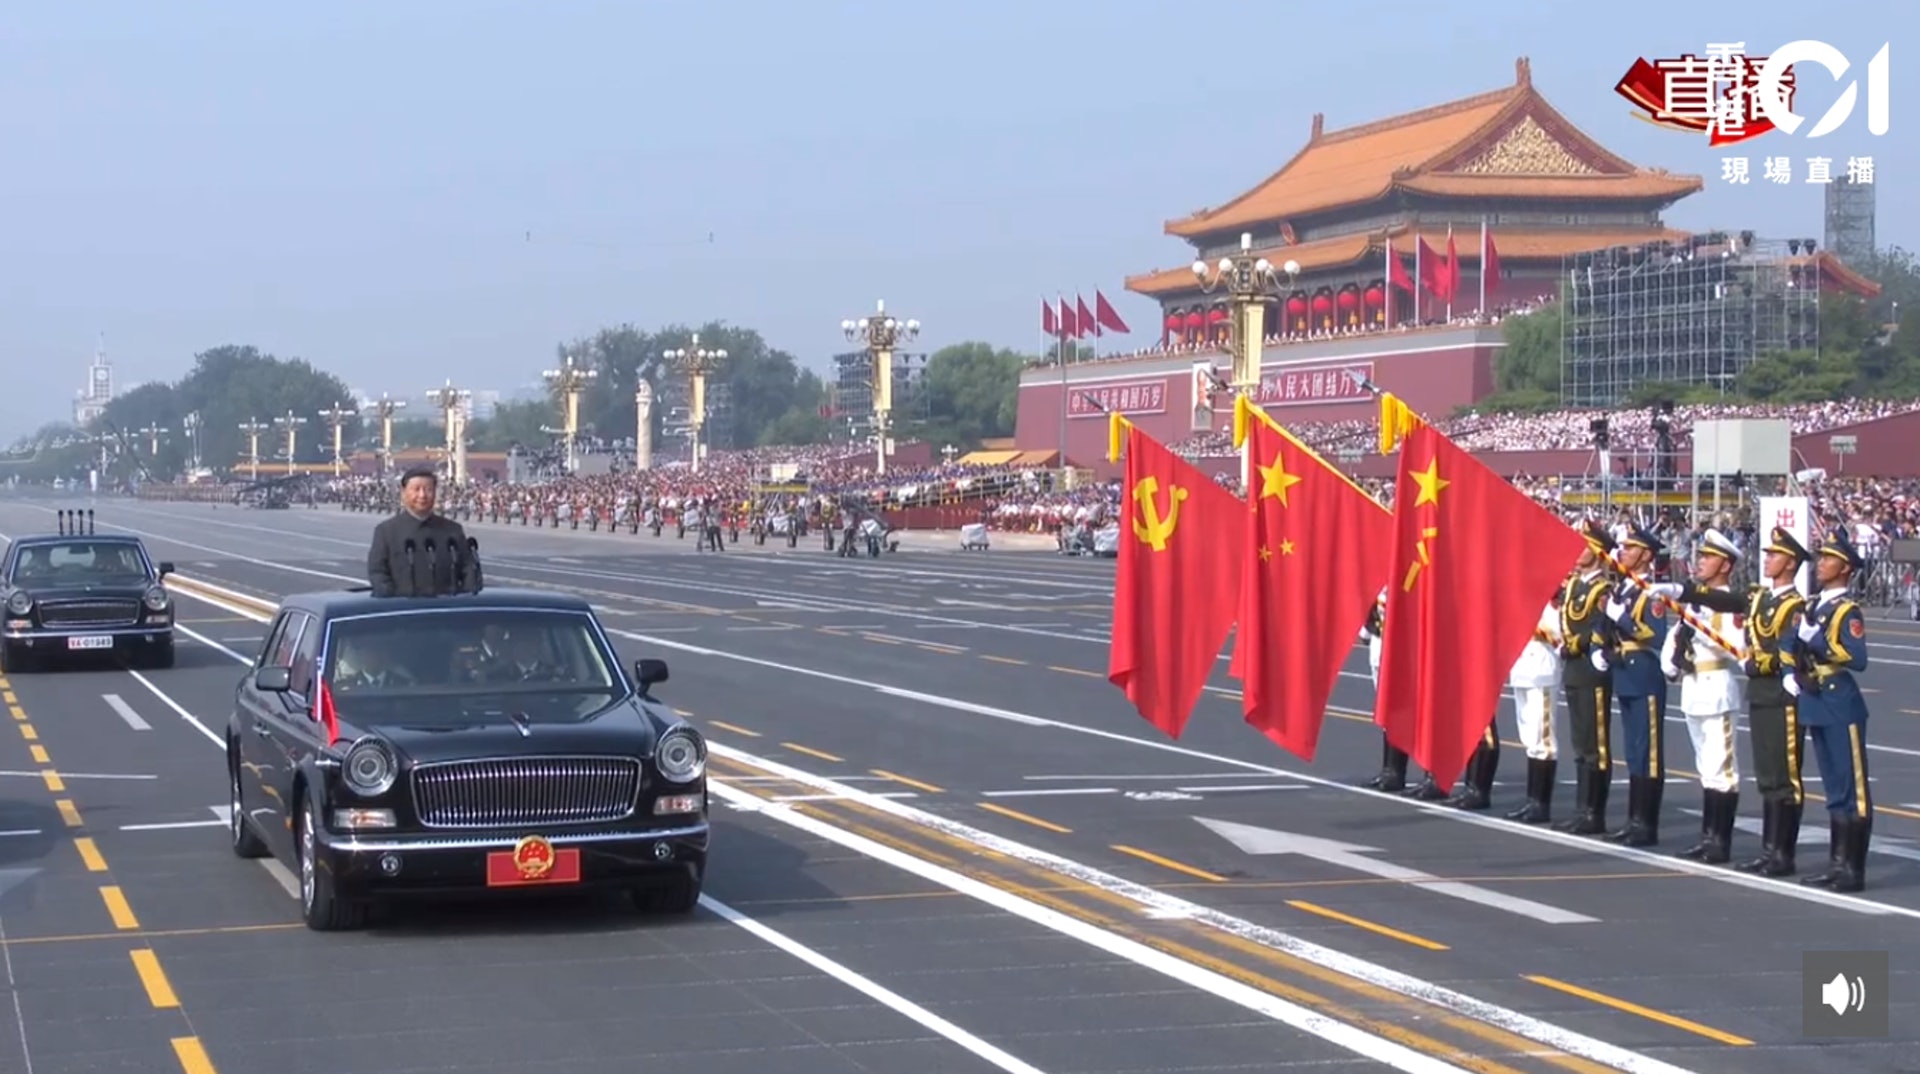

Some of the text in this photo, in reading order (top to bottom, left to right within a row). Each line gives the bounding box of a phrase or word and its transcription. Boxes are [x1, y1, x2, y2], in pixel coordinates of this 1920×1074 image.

[1246, 369, 1367, 401] 界人民大团结万
